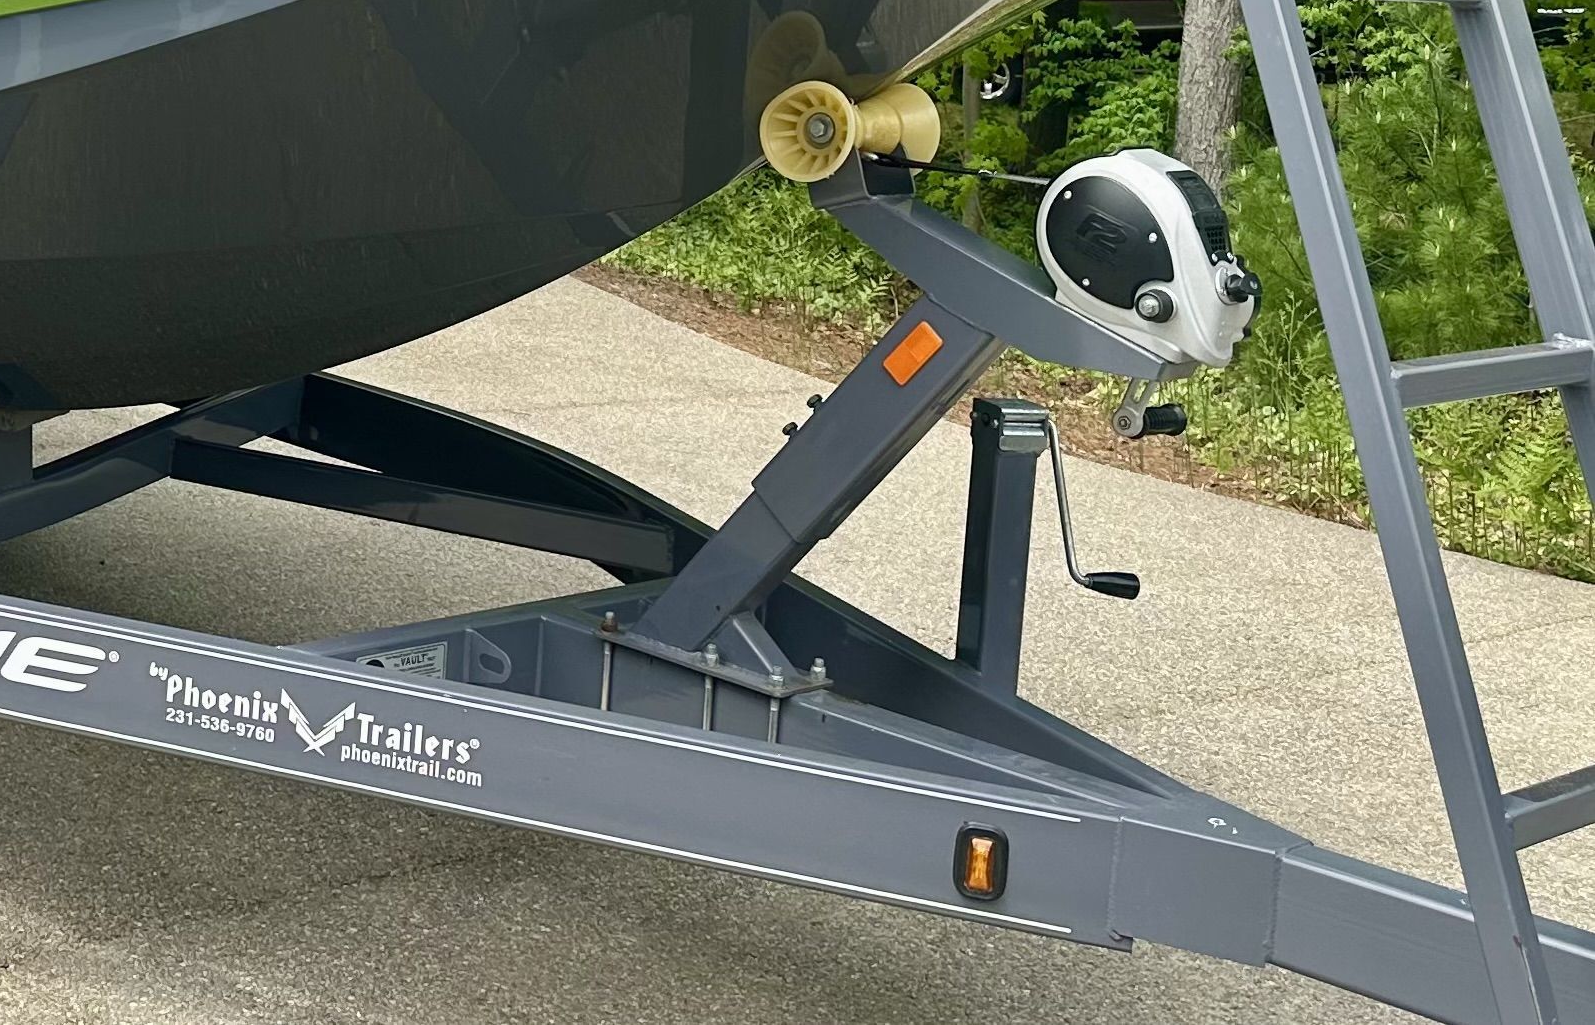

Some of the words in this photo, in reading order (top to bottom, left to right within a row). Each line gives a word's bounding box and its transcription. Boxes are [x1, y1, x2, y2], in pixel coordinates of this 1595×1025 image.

[400, 653, 426, 667] VAULT
[148, 661, 169, 681] by
[165, 673, 279, 724] Phoenix
[165, 707, 276, 743] 231-536-9760
[340, 743, 483, 787] phoenixtrail.com
